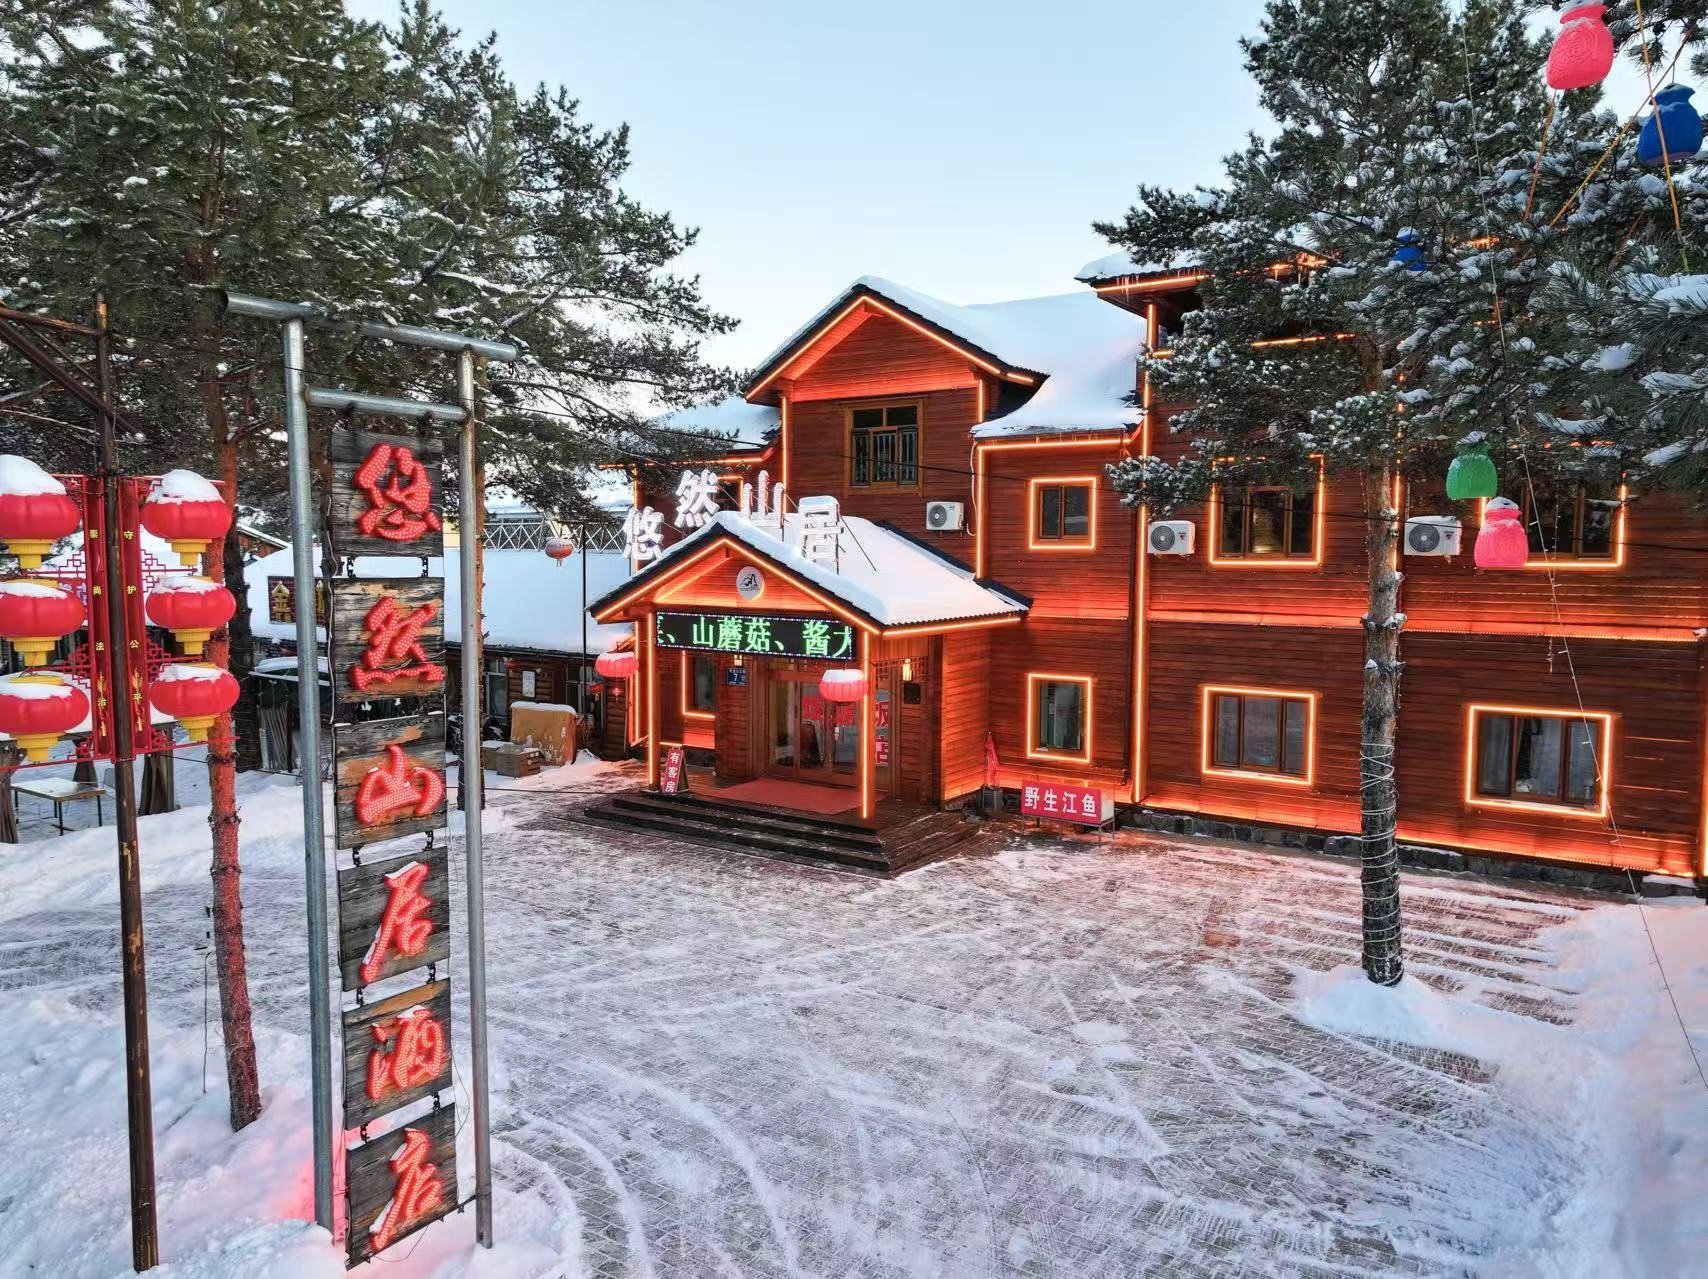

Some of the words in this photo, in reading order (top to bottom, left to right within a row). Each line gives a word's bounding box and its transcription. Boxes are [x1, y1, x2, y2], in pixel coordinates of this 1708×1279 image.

[623, 468, 844, 567] 悠然山居
[89, 528, 107, 708] 崇尚法治
[123, 530, 143, 701] 守护公平
[664, 751, 681, 793] 有客房
[1024, 786, 1097, 818] 野生江鱼
